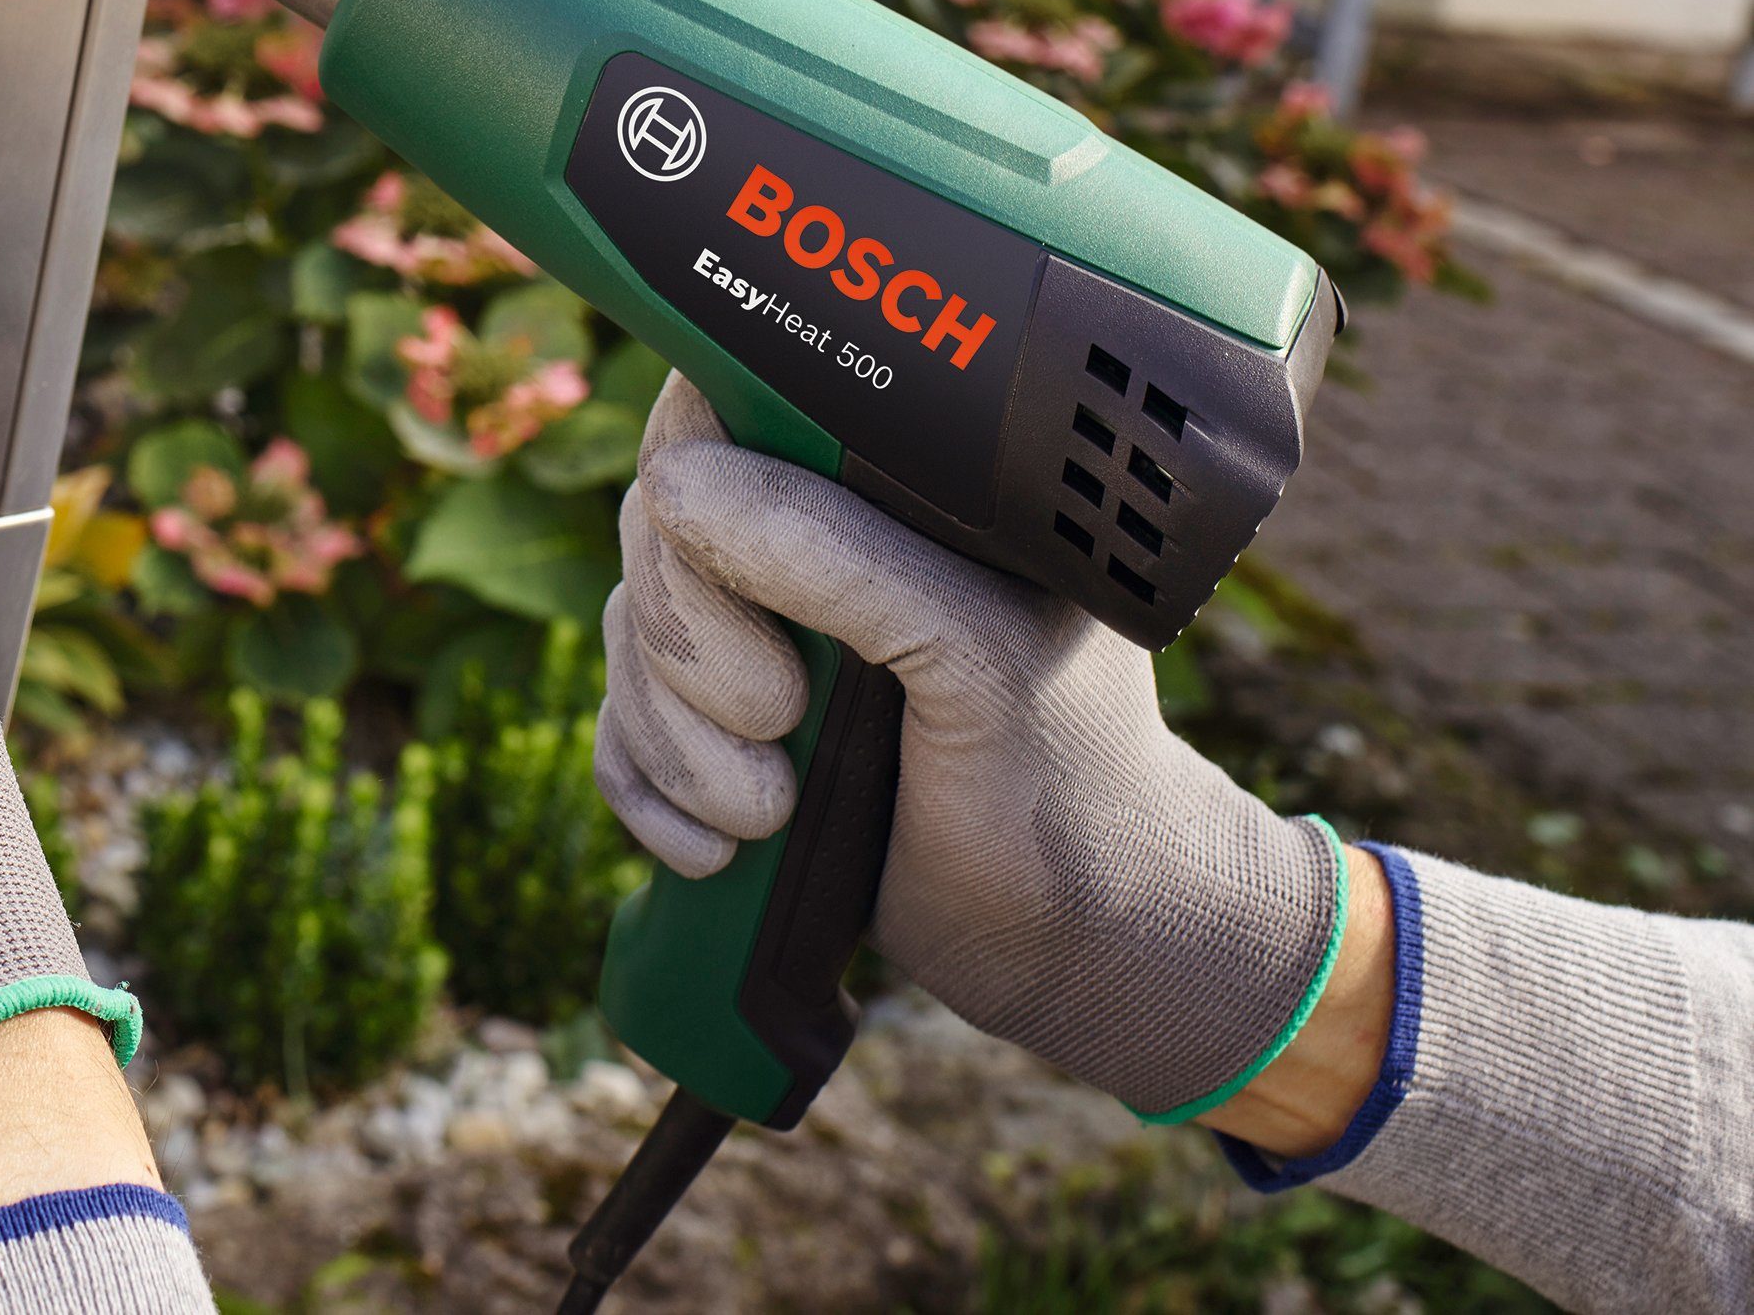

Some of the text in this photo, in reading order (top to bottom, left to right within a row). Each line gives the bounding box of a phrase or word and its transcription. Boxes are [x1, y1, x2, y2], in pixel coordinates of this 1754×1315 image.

[692, 248, 894, 389] EasyHeat 500
[726, 164, 997, 371] BOSCH
